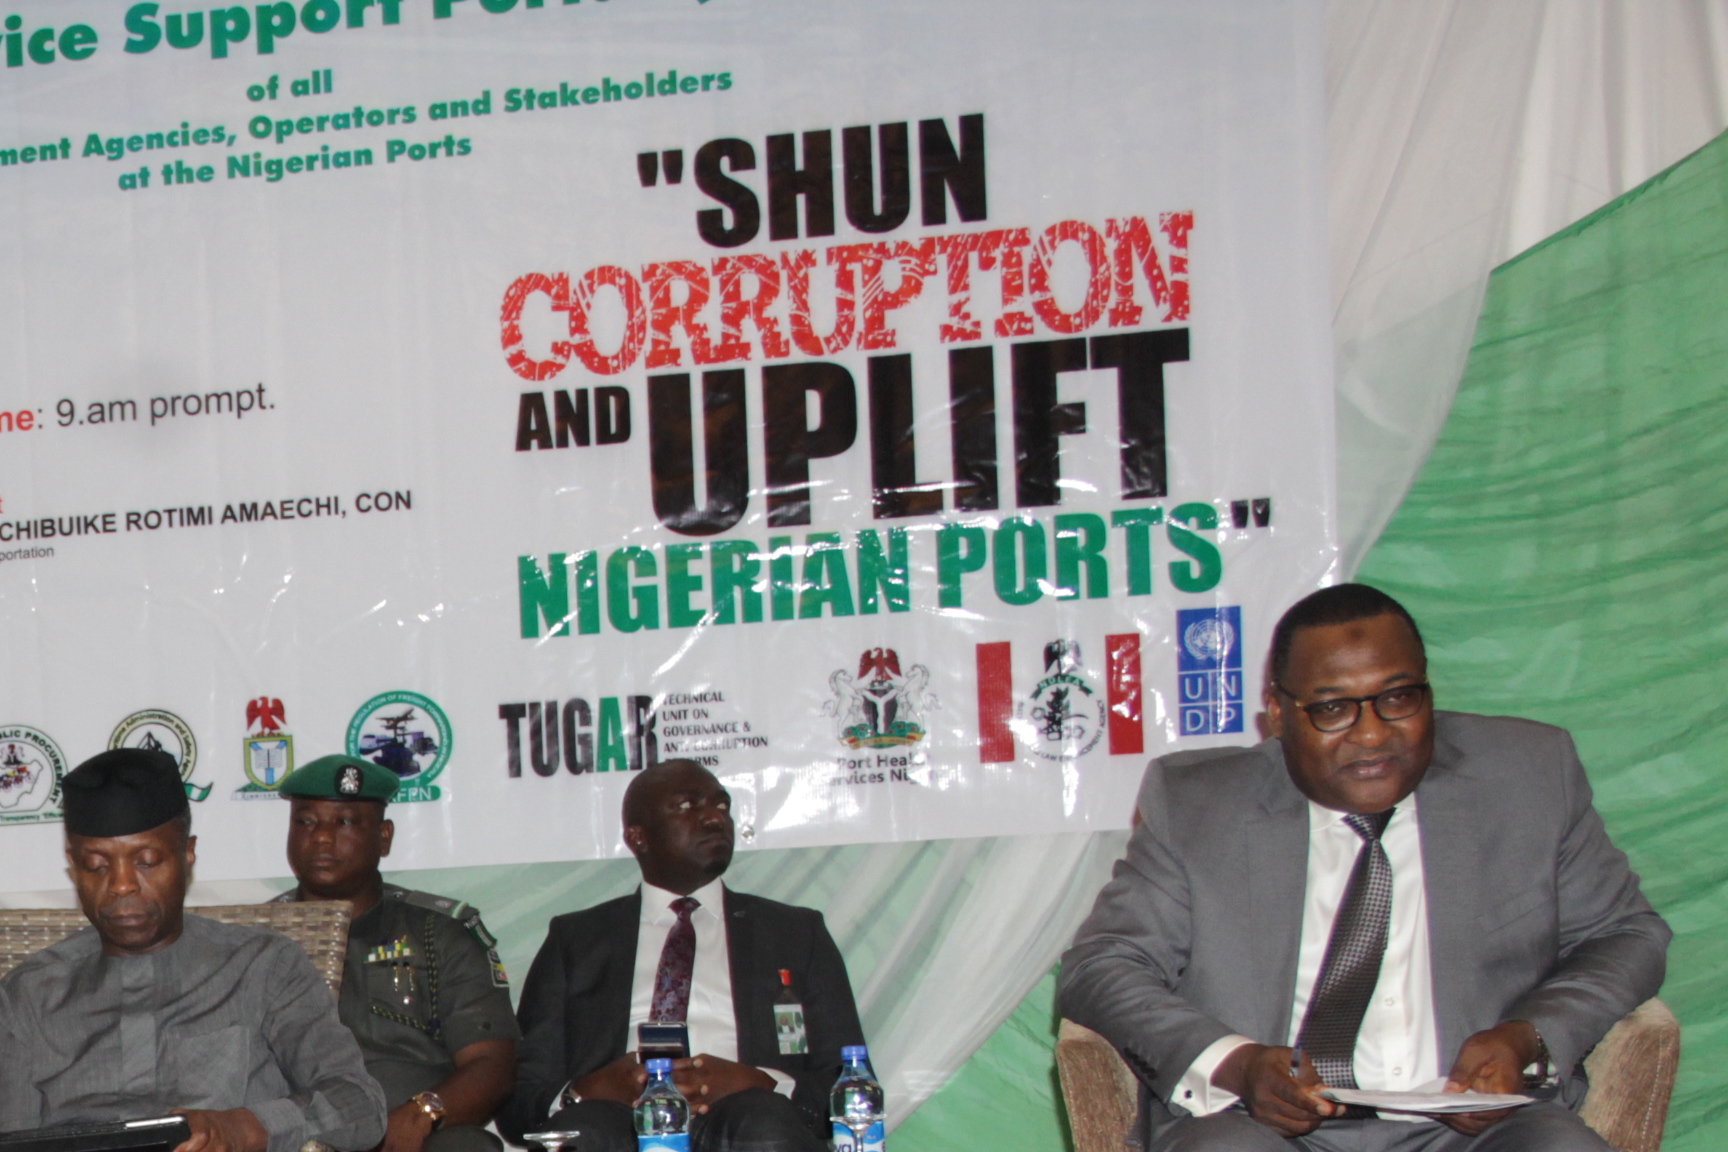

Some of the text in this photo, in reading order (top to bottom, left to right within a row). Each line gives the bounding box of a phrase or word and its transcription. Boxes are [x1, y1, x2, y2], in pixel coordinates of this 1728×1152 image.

[82, 117, 237, 160] Agencies,
[248, 104, 418, 146] Operators
[428, 90, 492, 120] and
[503, 70, 733, 113] Stakeholders
[246, 68, 333, 101] of all
[118, 134, 472, 192] at the Nigerian Ports
[636, 112, 988, 248] "SHUN
[499, 210, 1194, 382] CORRUPTION
[55, 398, 138, 428] 9.am
[149, 382, 276, 422] prompt.
[514, 327, 1191, 537] AND UPLIFT
[125, 507, 214, 533] ROTIMI
[220, 496, 348, 525] AMAECHI,
[355, 490, 413, 513] CON
[517, 497, 1272, 639] NIGERIAN PORTS"
[662, 708, 709, 722] UNIT ON
[663, 691, 726, 706] TECHNICAL
[663, 721, 751, 738] GOVERNANCE &
[24, 730, 64, 804] PROCUREMENT
[498, 695, 659, 778] TUGAR
